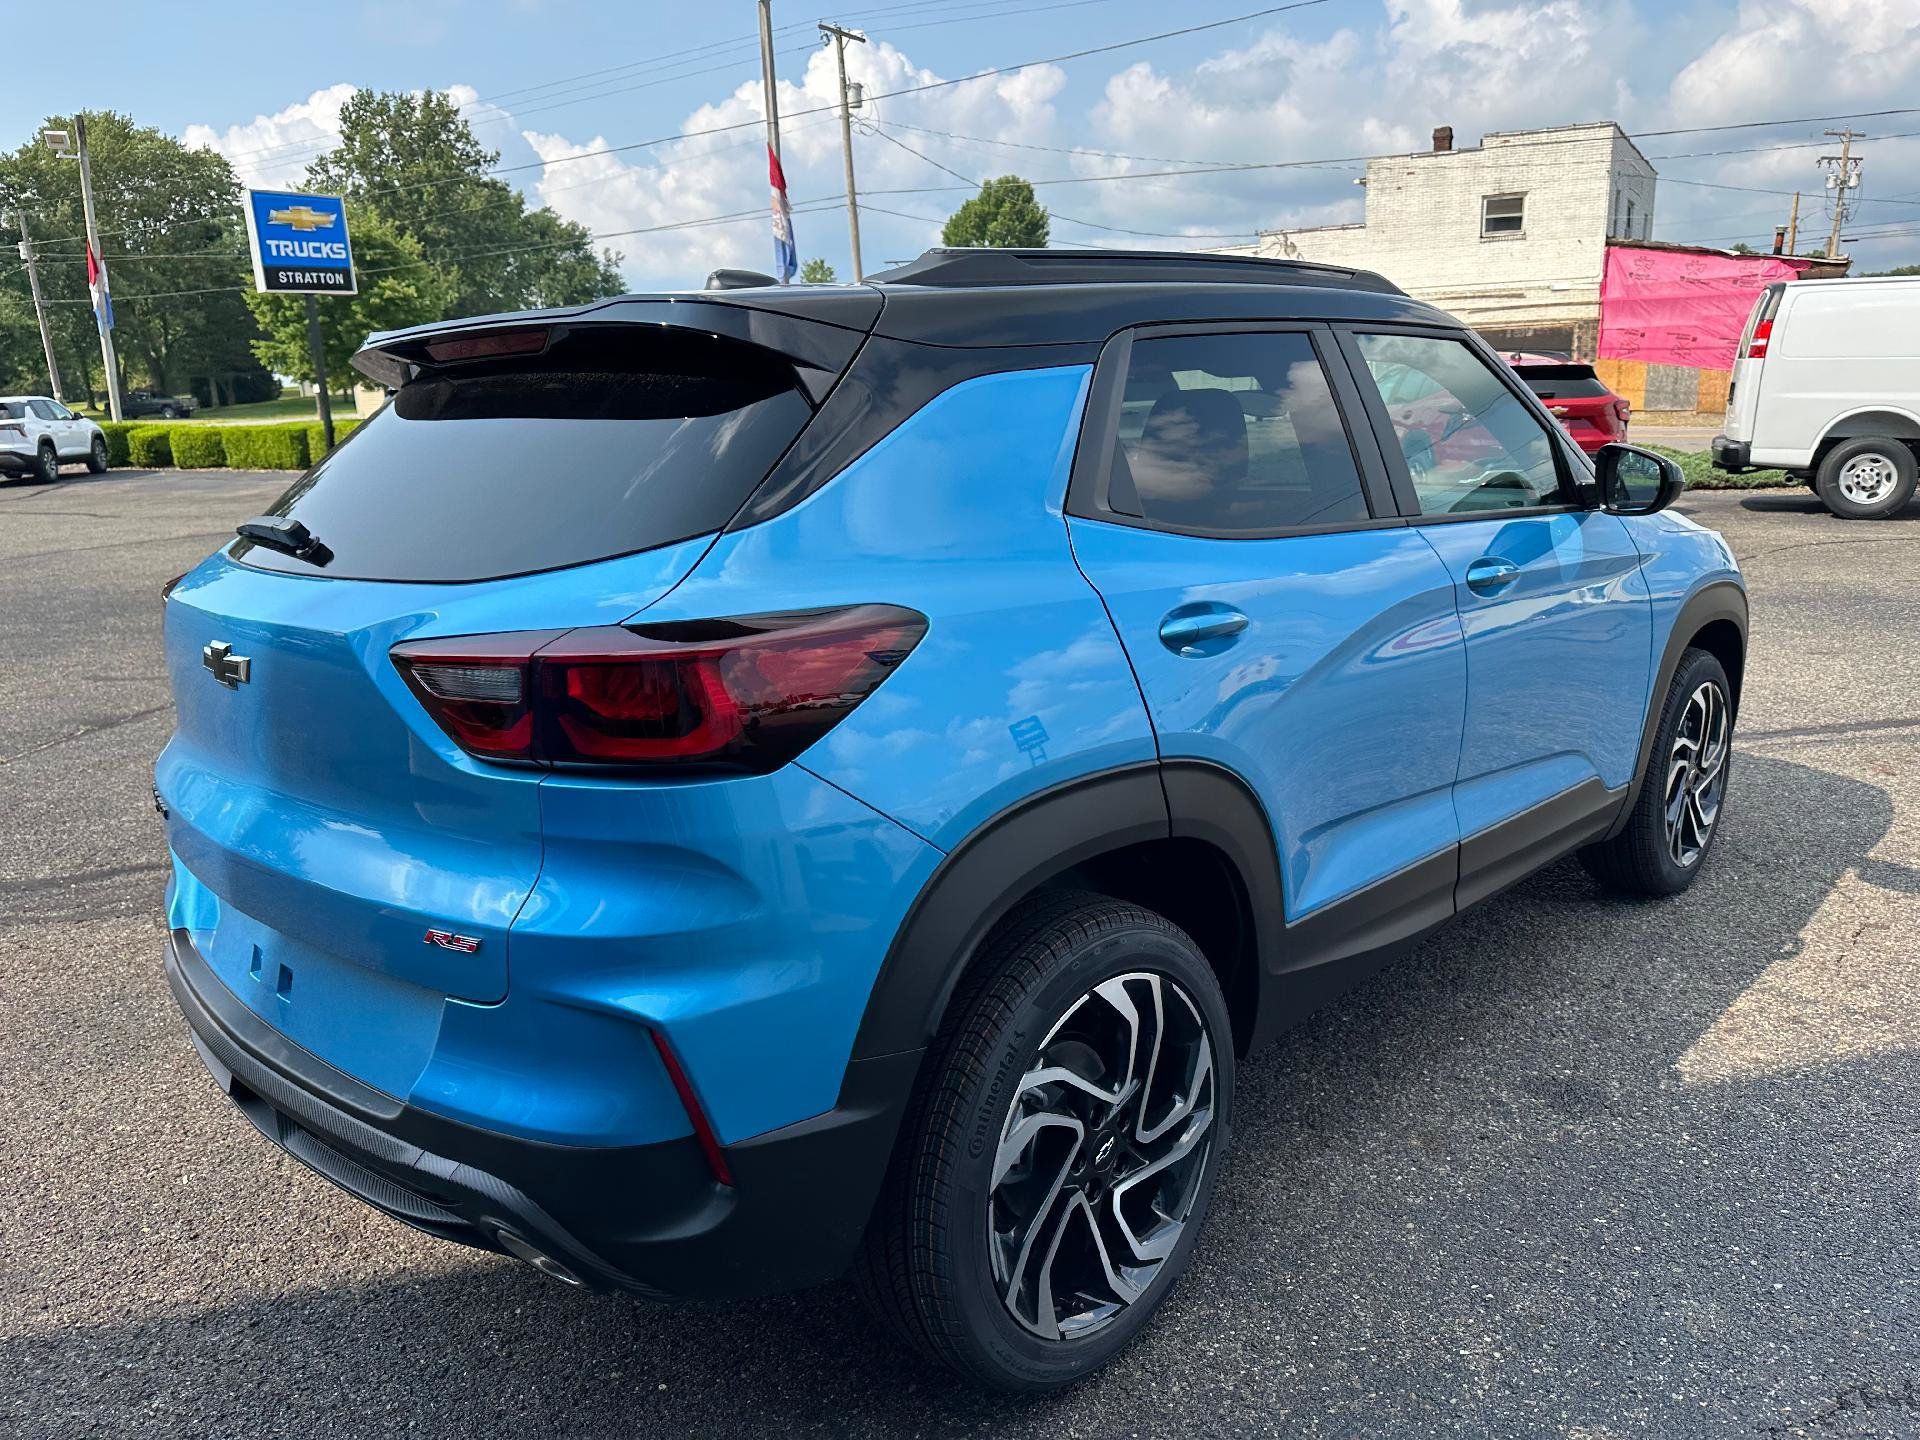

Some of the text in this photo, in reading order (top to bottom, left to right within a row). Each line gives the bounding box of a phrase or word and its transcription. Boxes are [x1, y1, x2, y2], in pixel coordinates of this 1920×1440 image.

[266, 239, 346, 259] TRUCKS
[278, 271, 344, 285] STRATTON
[423, 928, 482, 953] RS
[967, 1041, 1019, 1160] Continental
